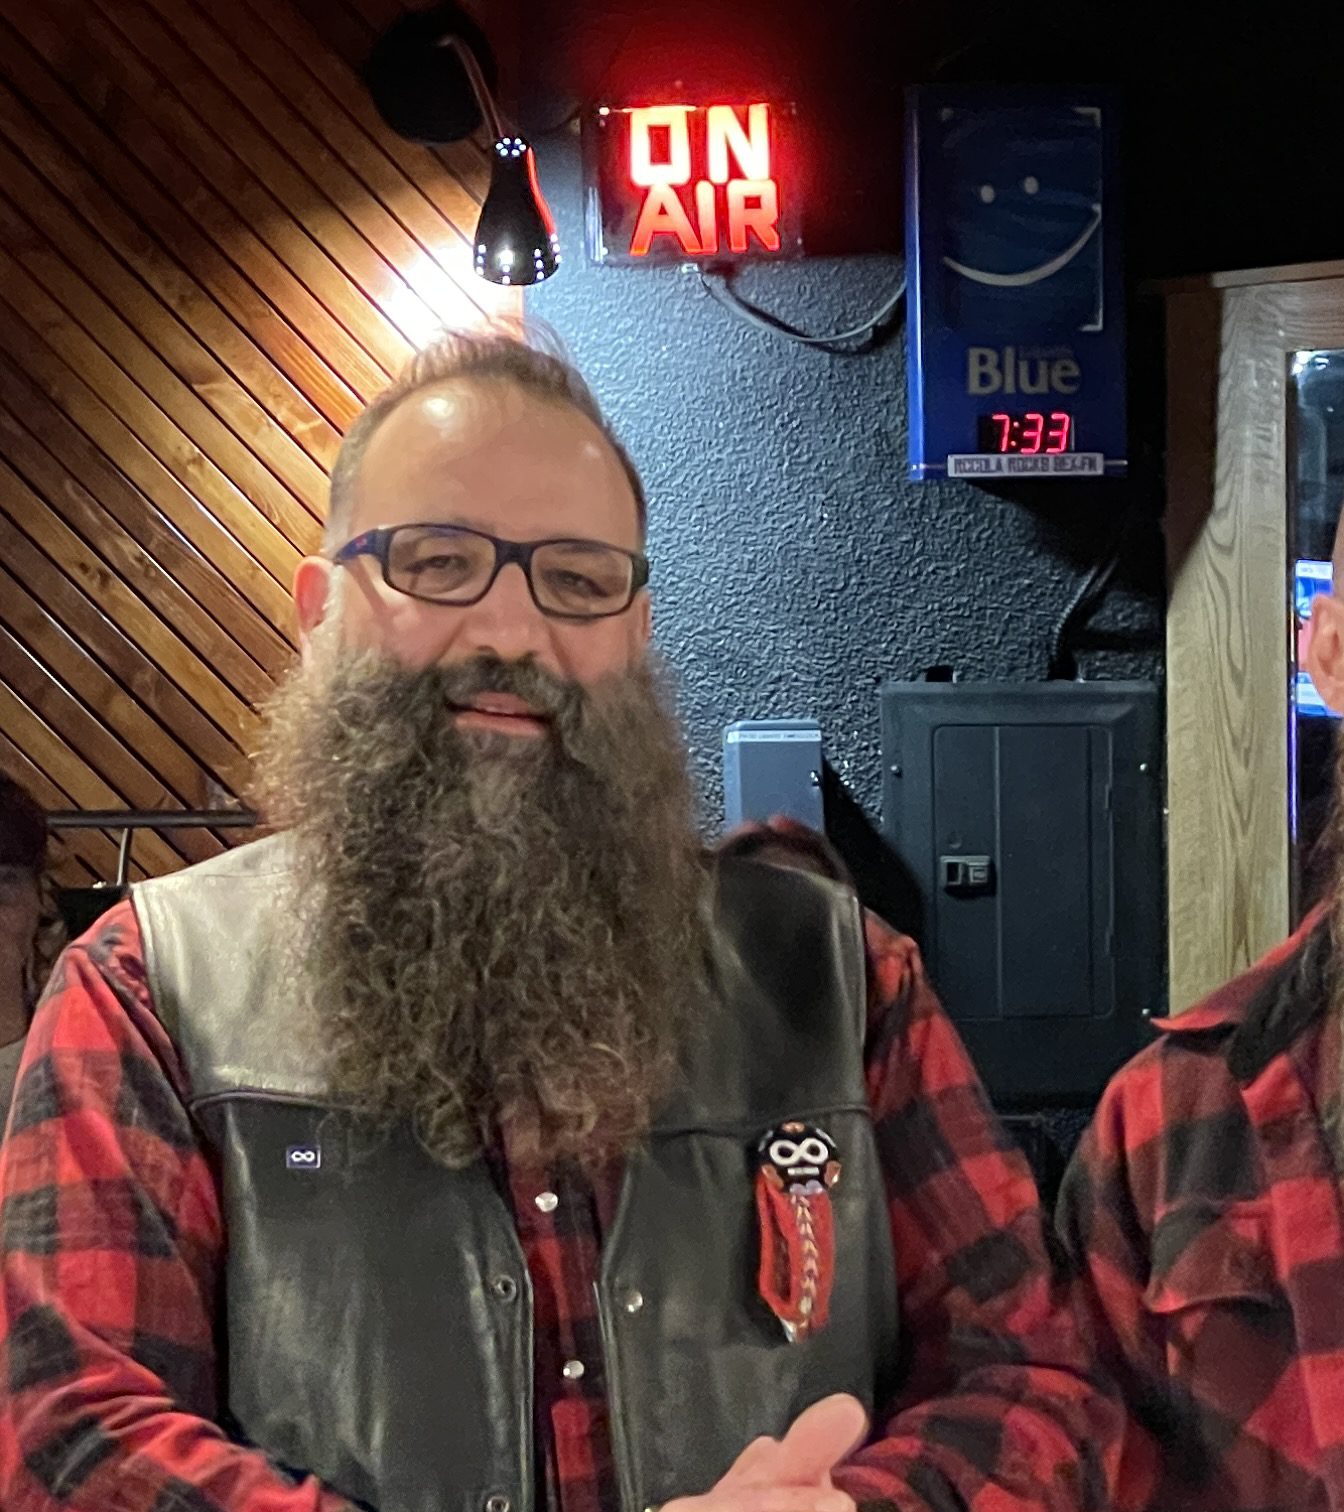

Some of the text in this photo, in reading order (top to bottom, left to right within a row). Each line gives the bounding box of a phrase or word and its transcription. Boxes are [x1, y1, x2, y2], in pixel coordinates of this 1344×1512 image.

[629, 102, 771, 188] ON
[630, 178, 781, 256] AIR
[968, 347, 1081, 395] Blue
[992, 412, 1071, 454] 7:33
